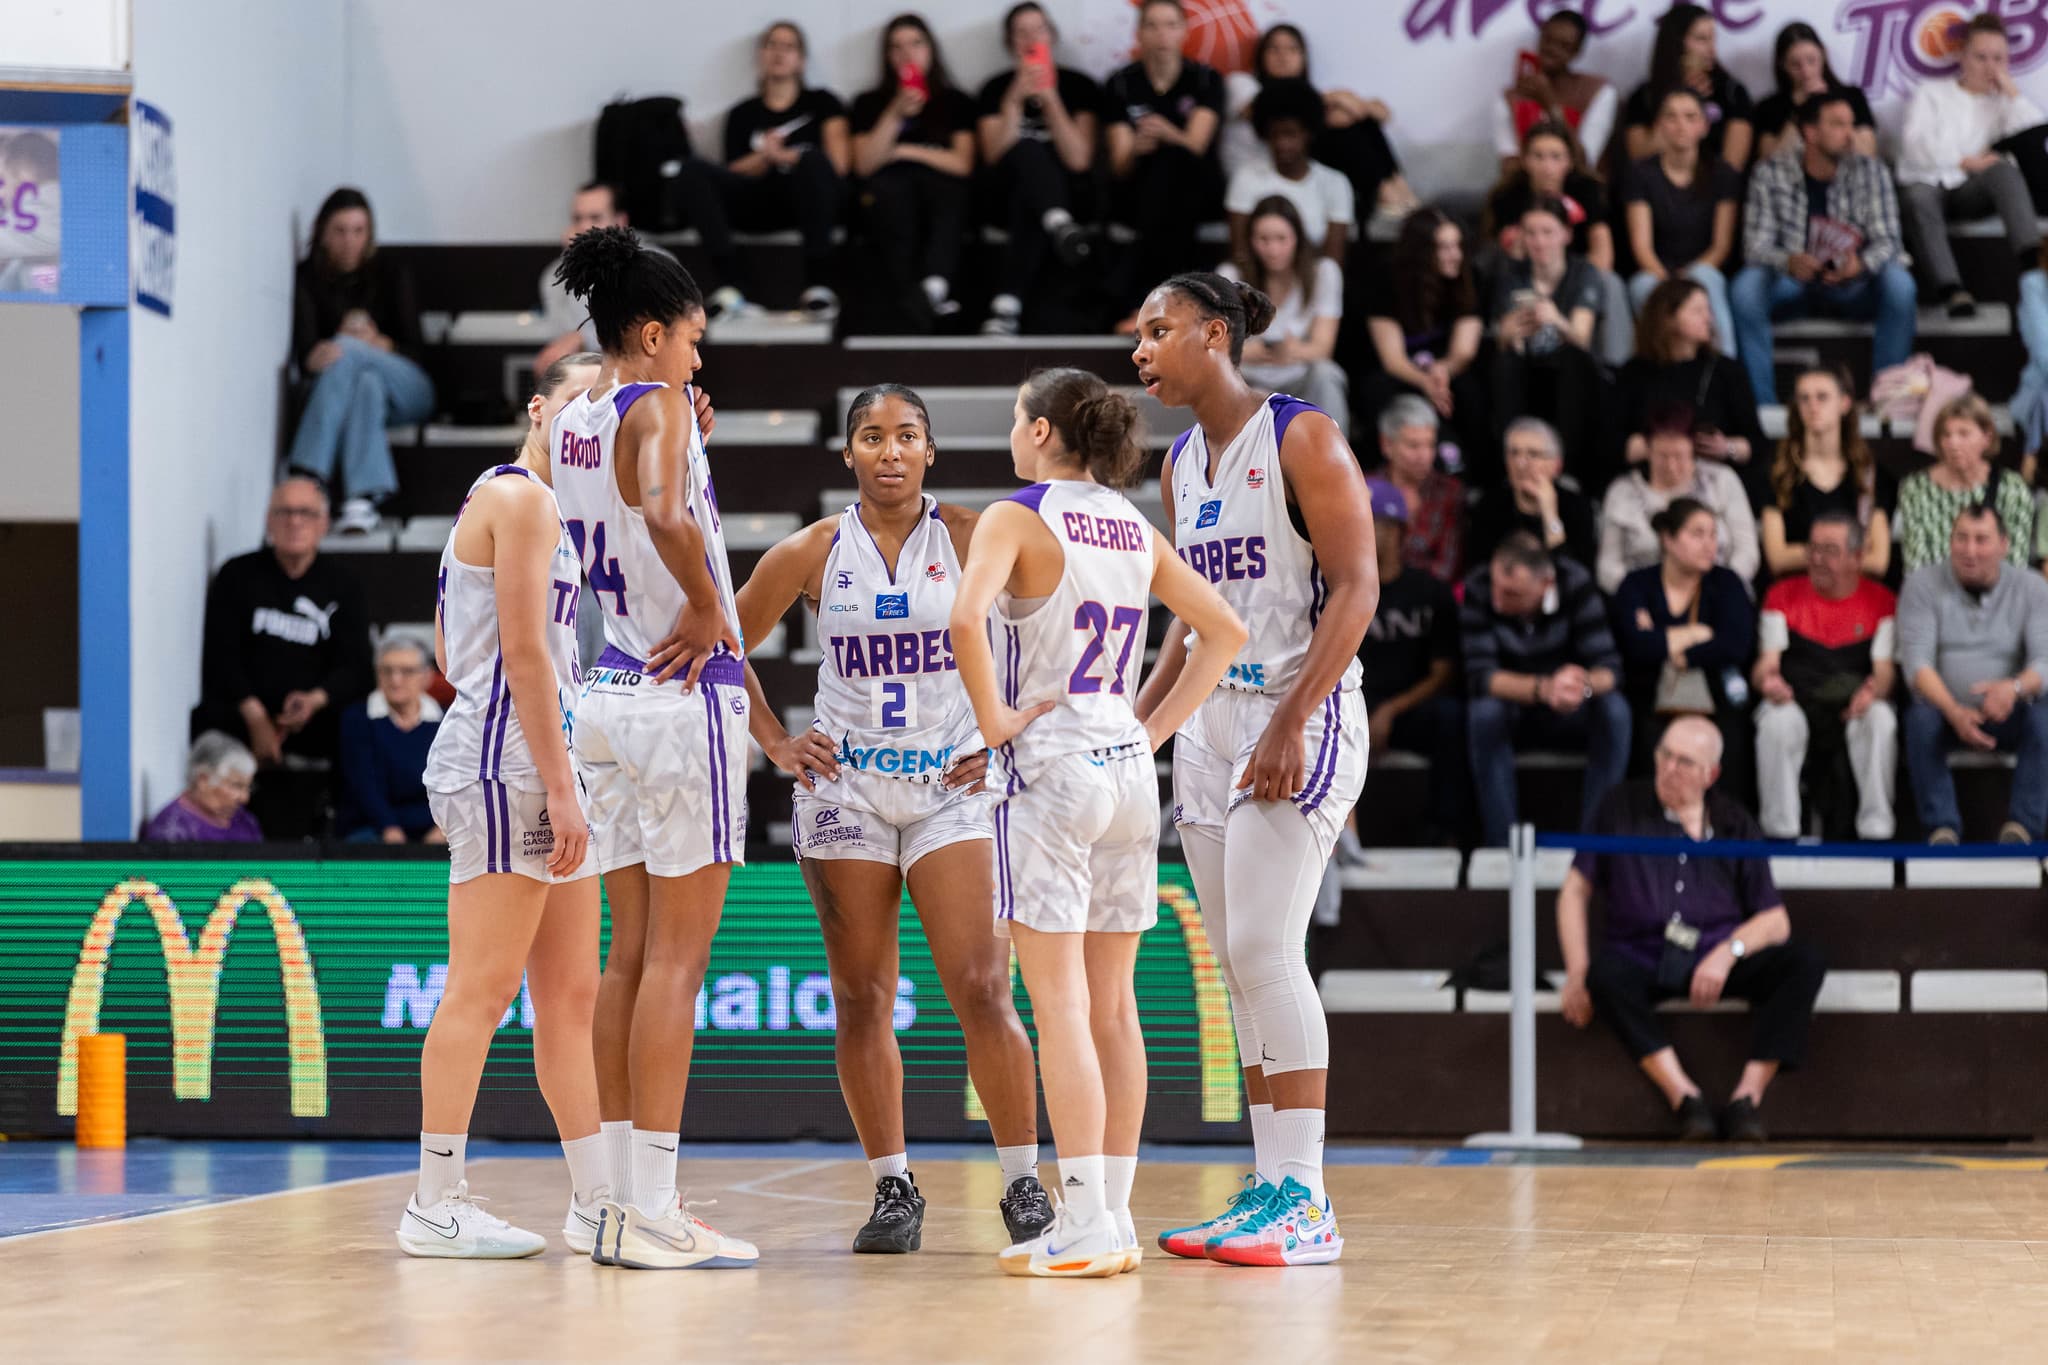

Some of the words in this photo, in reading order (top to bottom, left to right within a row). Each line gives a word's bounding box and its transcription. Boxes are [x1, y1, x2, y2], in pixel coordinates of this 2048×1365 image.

[1062, 511, 1147, 553] CELERIER
[1176, 536, 1266, 584] RBES
[1068, 600, 1143, 695] 27
[882, 683, 906, 728] 2
